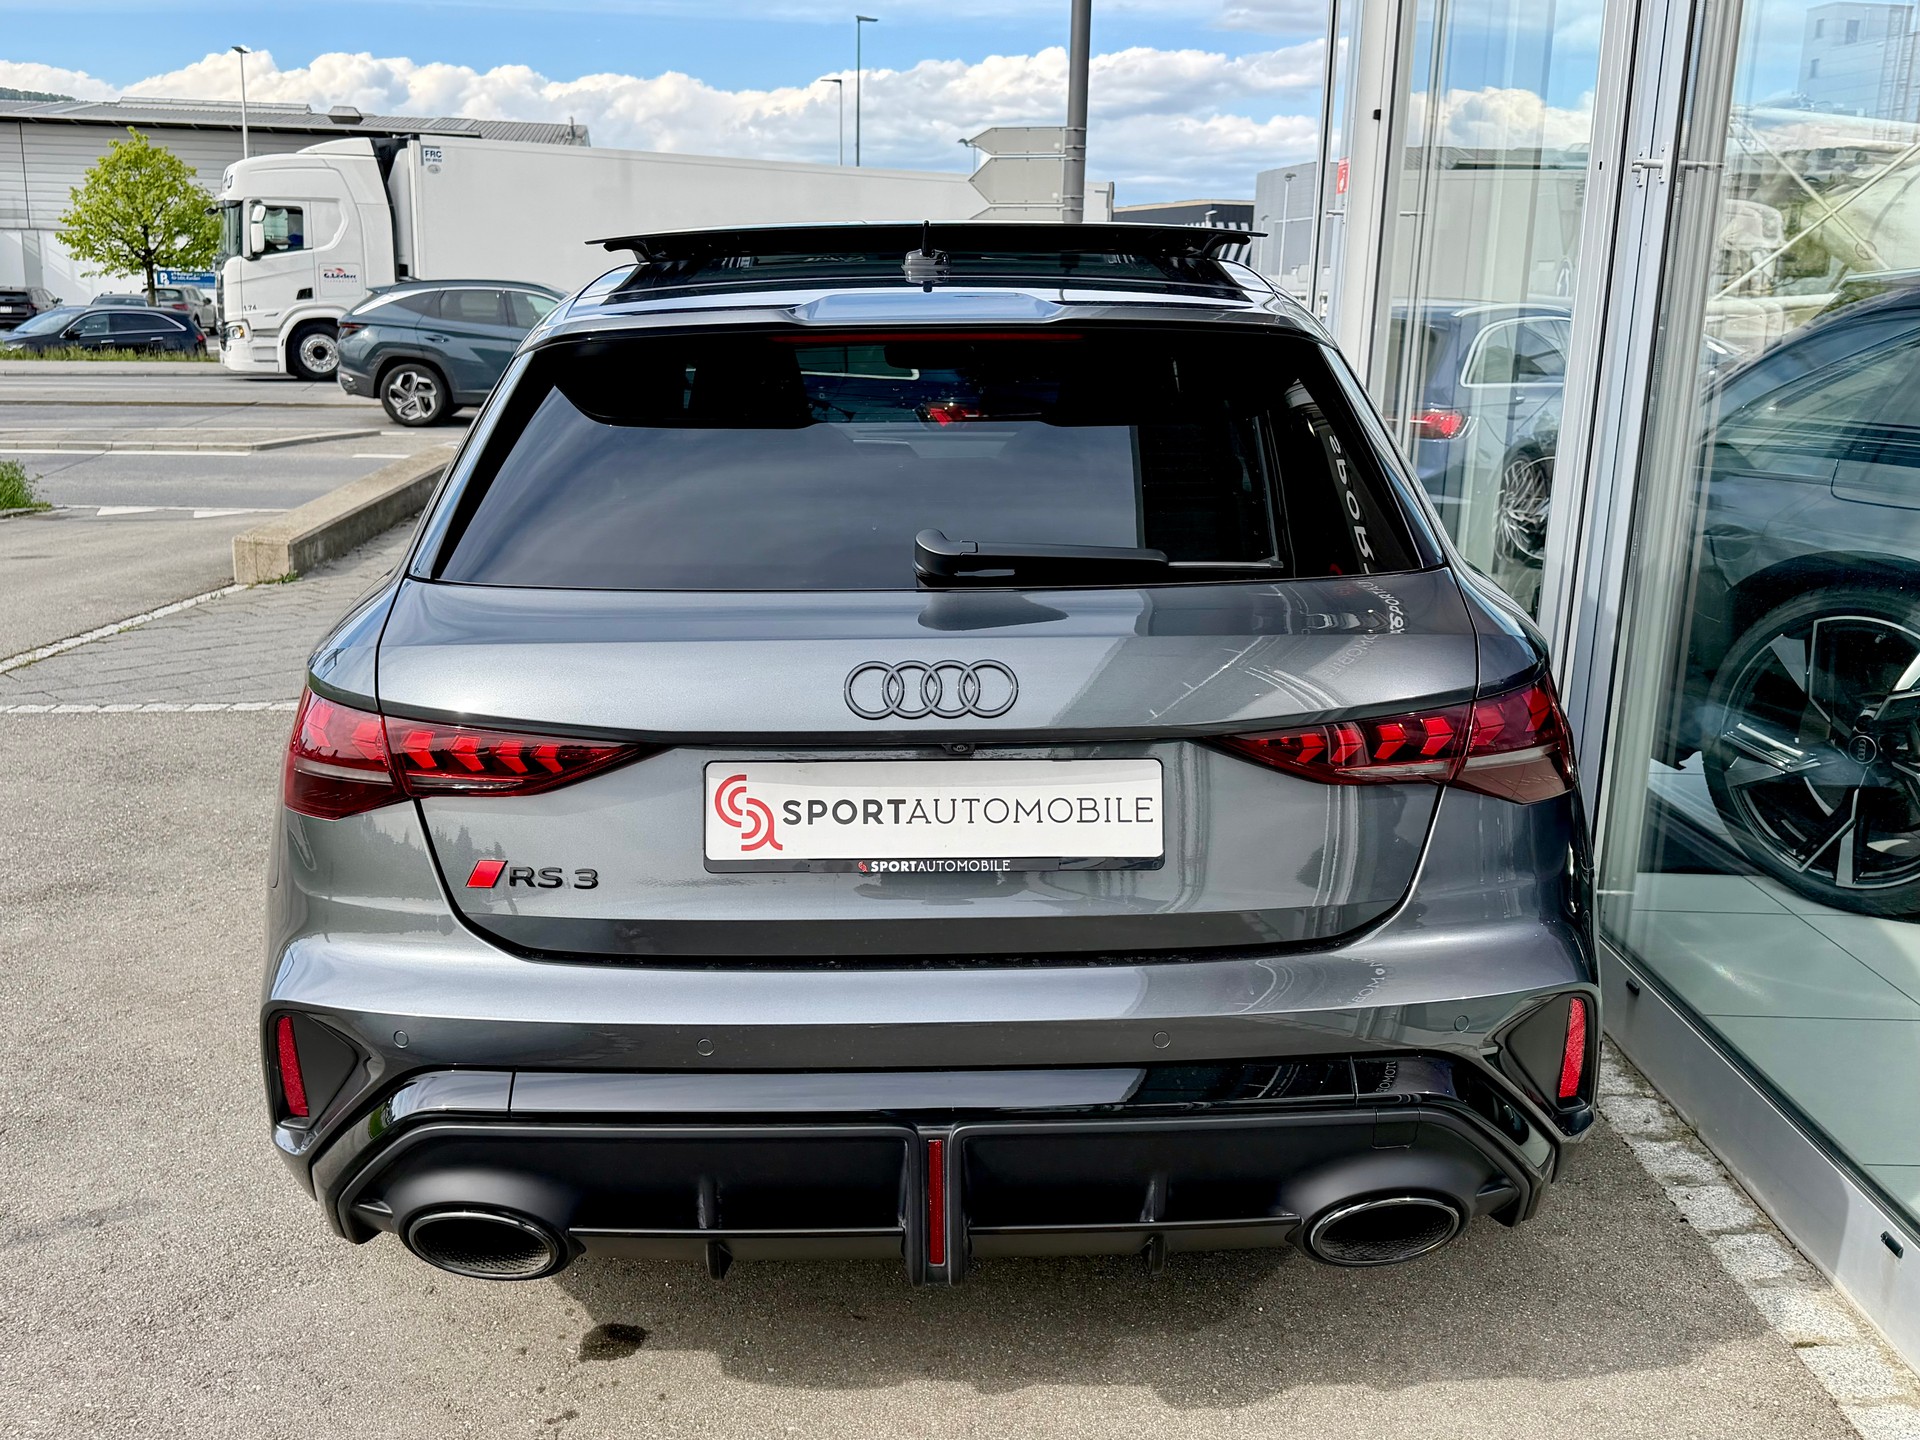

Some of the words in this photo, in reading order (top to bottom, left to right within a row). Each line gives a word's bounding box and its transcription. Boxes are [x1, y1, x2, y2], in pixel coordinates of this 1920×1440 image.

[425, 150, 442, 158] FRC
[782, 797, 1154, 826] SPORTAUTOMOBILE
[871, 859, 1011, 872] SPORTAUTOMOBILE
[508, 866, 564, 888] RS
[573, 868, 599, 889] 3
